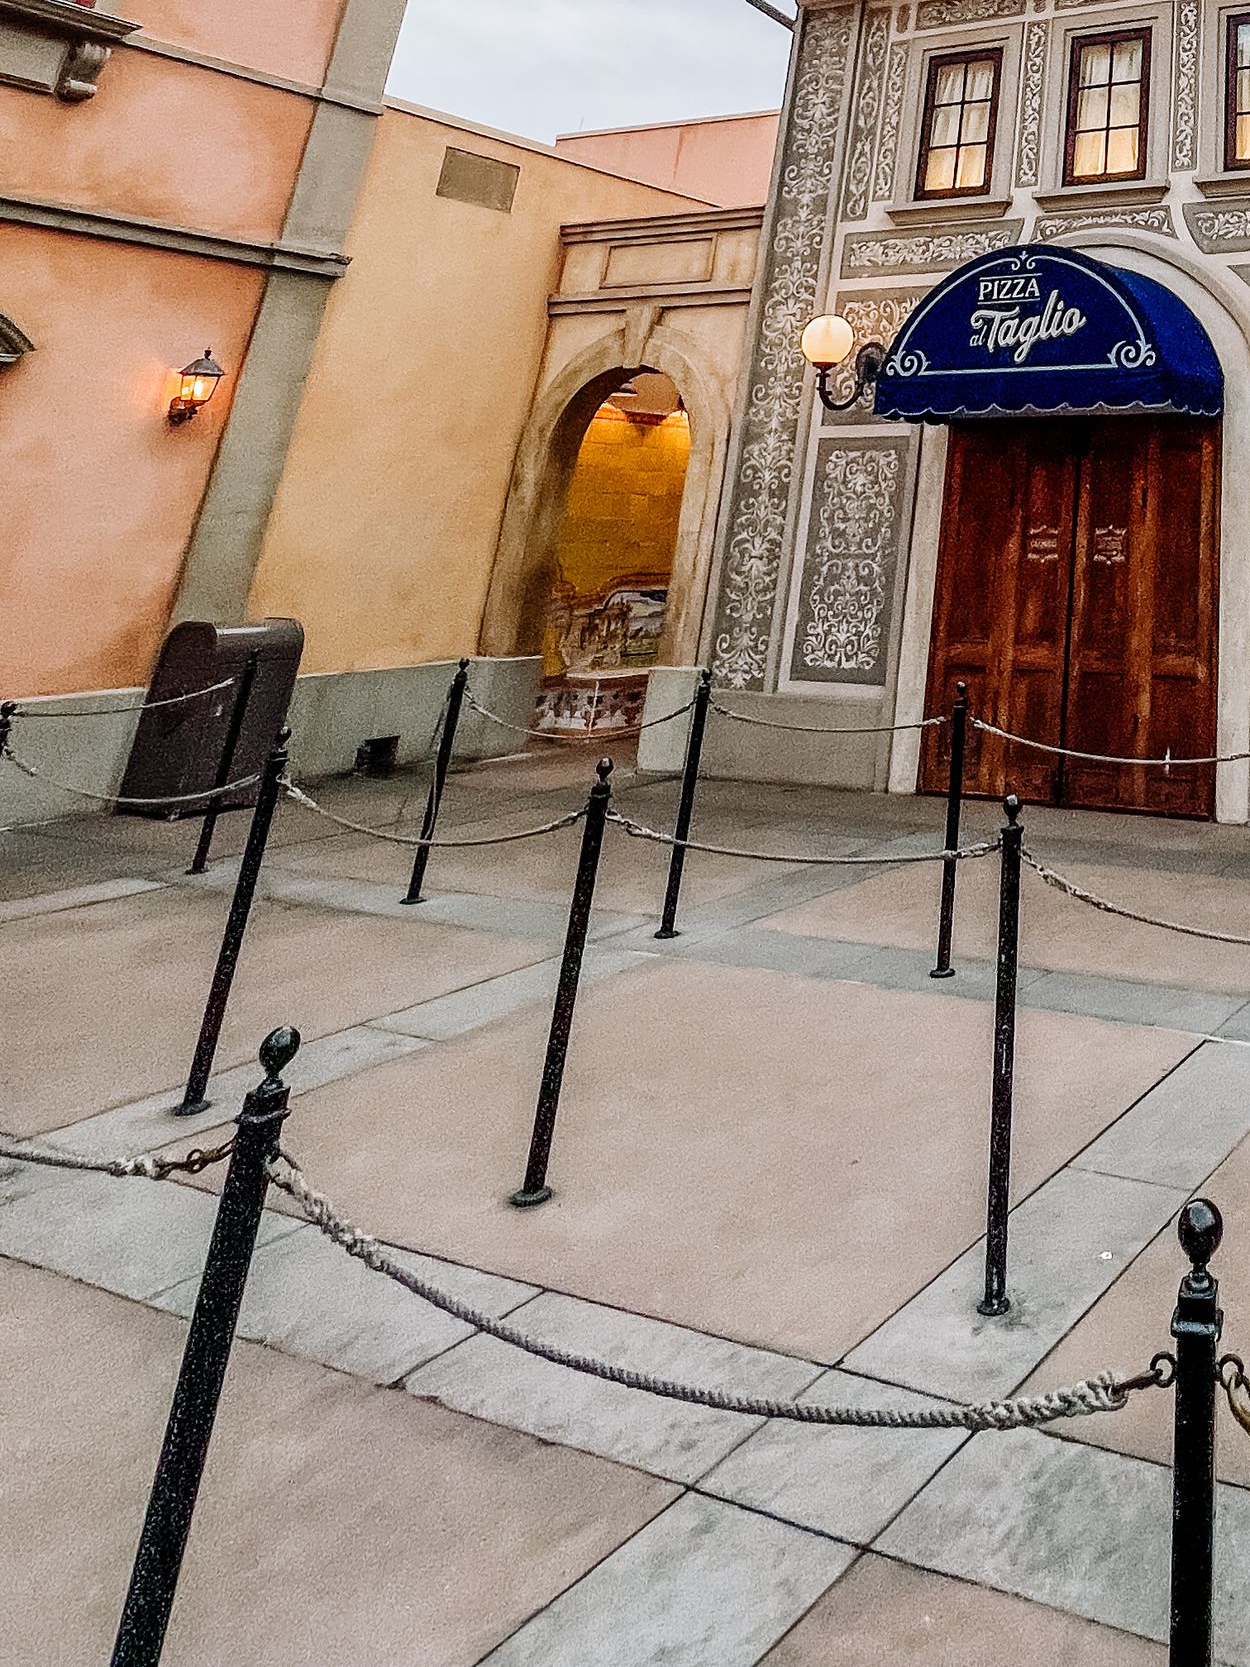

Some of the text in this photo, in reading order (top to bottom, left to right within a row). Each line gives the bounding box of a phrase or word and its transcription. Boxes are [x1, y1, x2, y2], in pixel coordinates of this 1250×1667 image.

[977, 277, 1041, 301] PIZZA
[969, 289, 1087, 364] al Taglio
